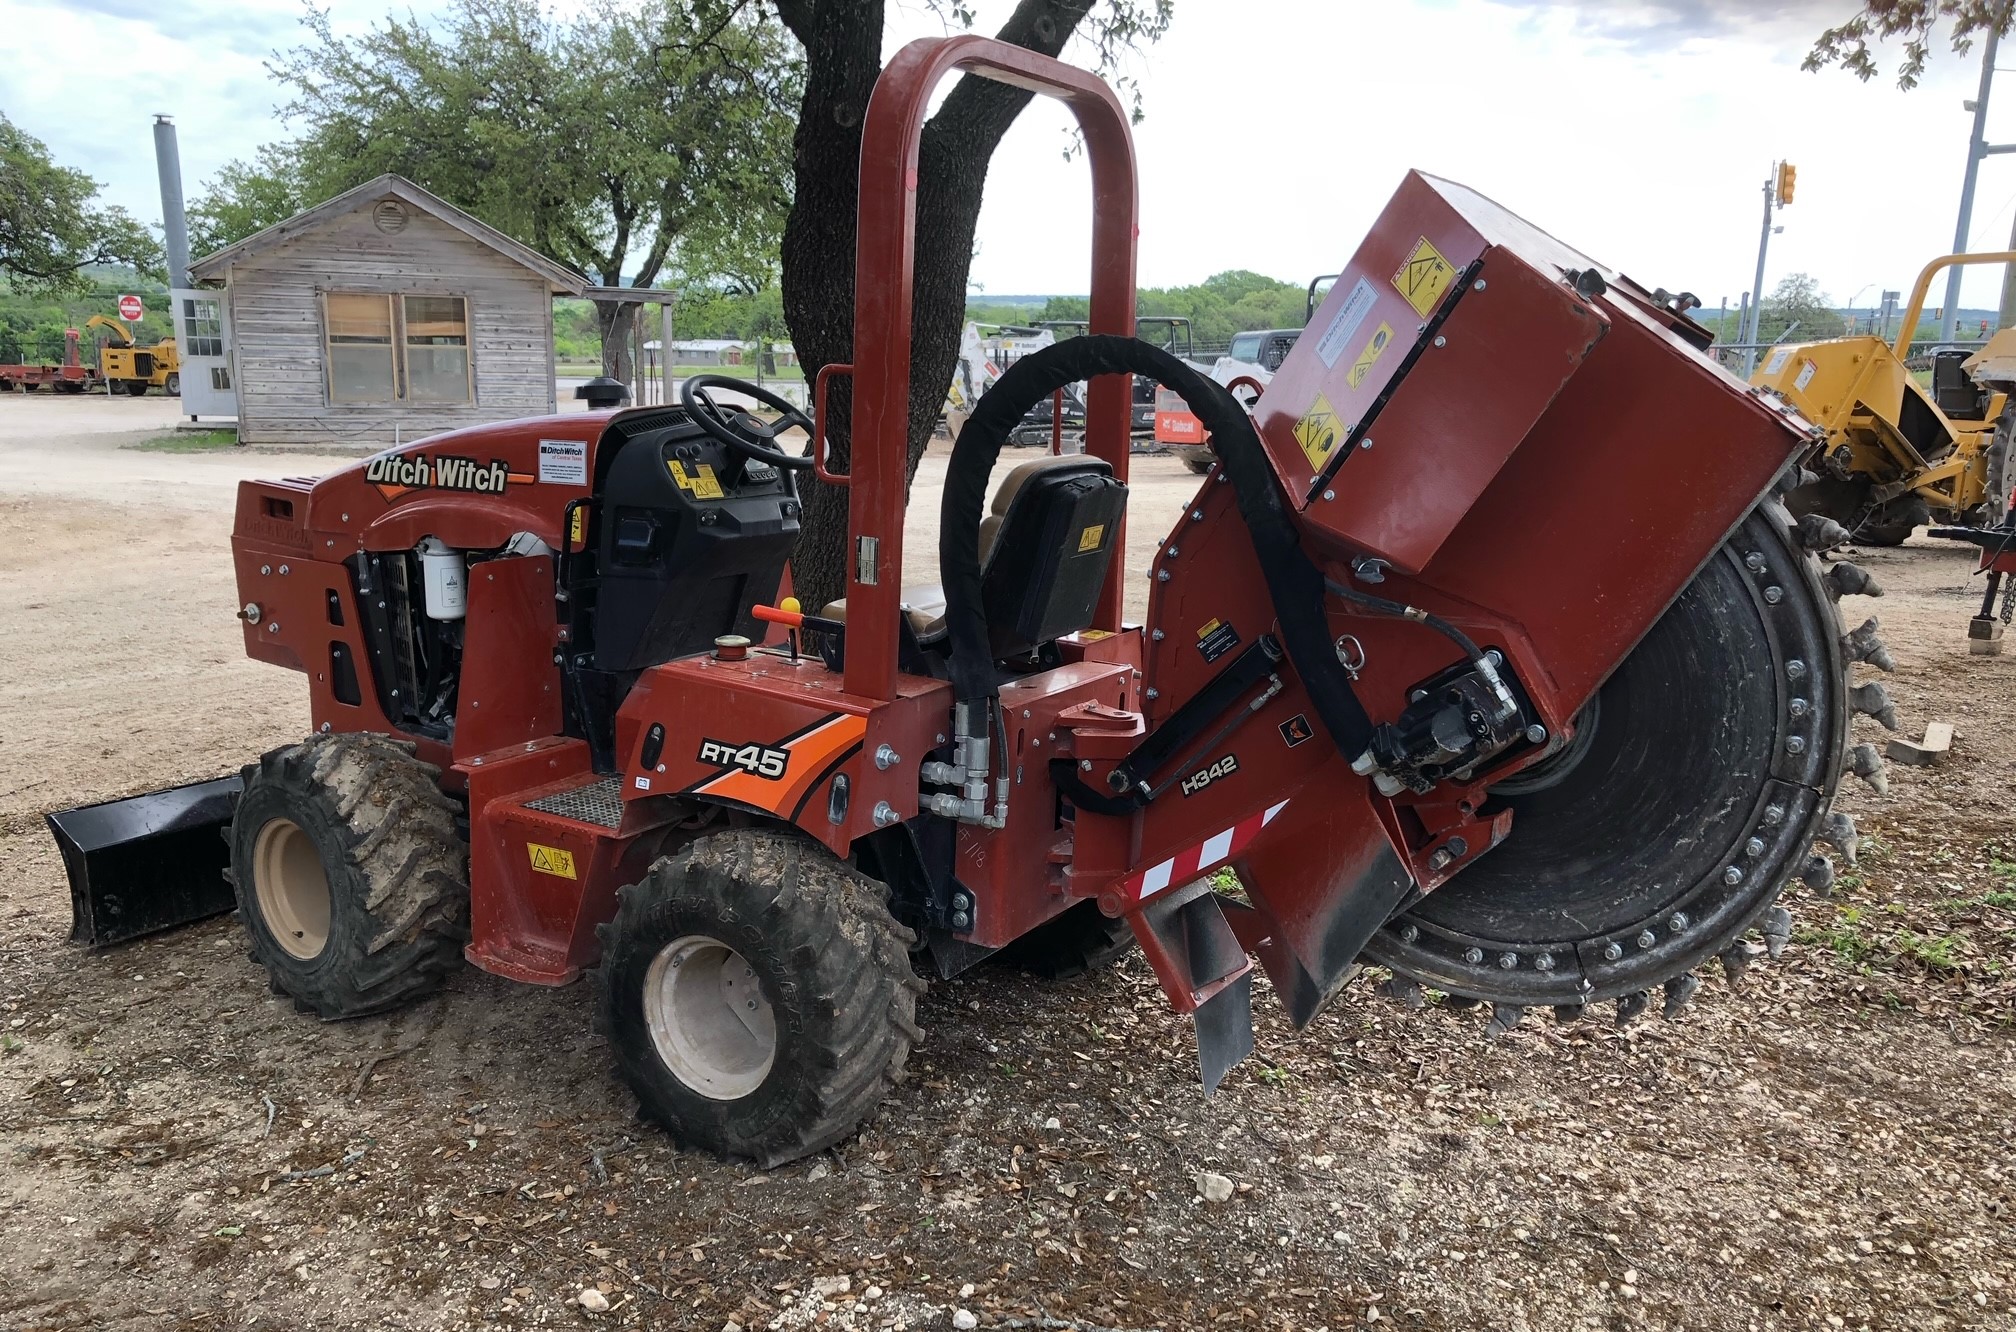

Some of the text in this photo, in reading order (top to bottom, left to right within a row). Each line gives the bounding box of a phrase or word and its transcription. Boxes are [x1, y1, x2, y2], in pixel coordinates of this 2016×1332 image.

[1399, 239, 1424, 273] DANGER
[1172, 420, 1194, 433] Bobcat
[548, 447, 582, 456] Ditch Witch
[367, 455, 506, 491] Ditch Witch
[700, 742, 787, 777] RT45
[1181, 755, 1237, 795] H342
